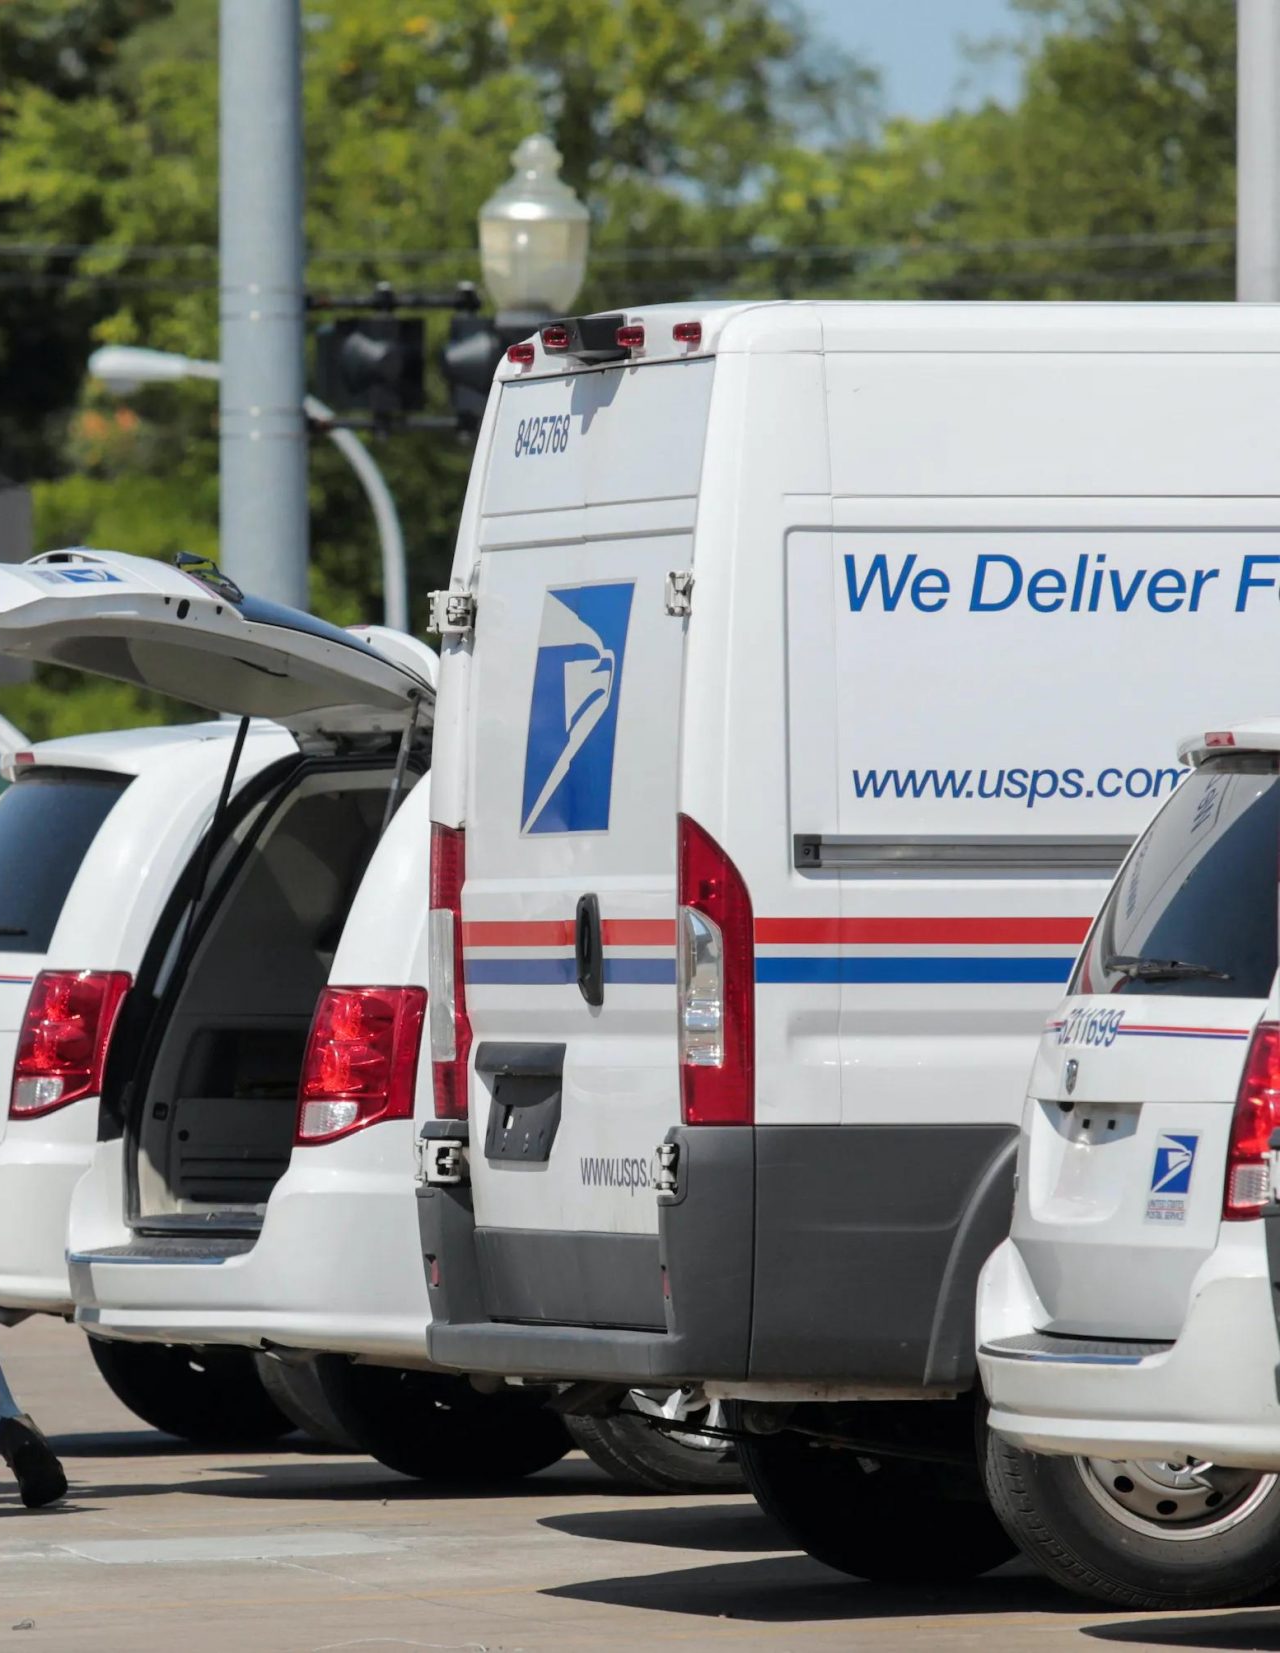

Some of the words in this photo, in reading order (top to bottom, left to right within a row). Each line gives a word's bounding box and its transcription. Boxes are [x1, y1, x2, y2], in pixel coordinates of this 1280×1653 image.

[515, 414, 570, 458] 8425768
[844, 554, 950, 613] We
[969, 554, 1220, 613] Deliver
[1235, 554, 1280, 612] F
[852, 767, 1192, 808] www.usps.com
